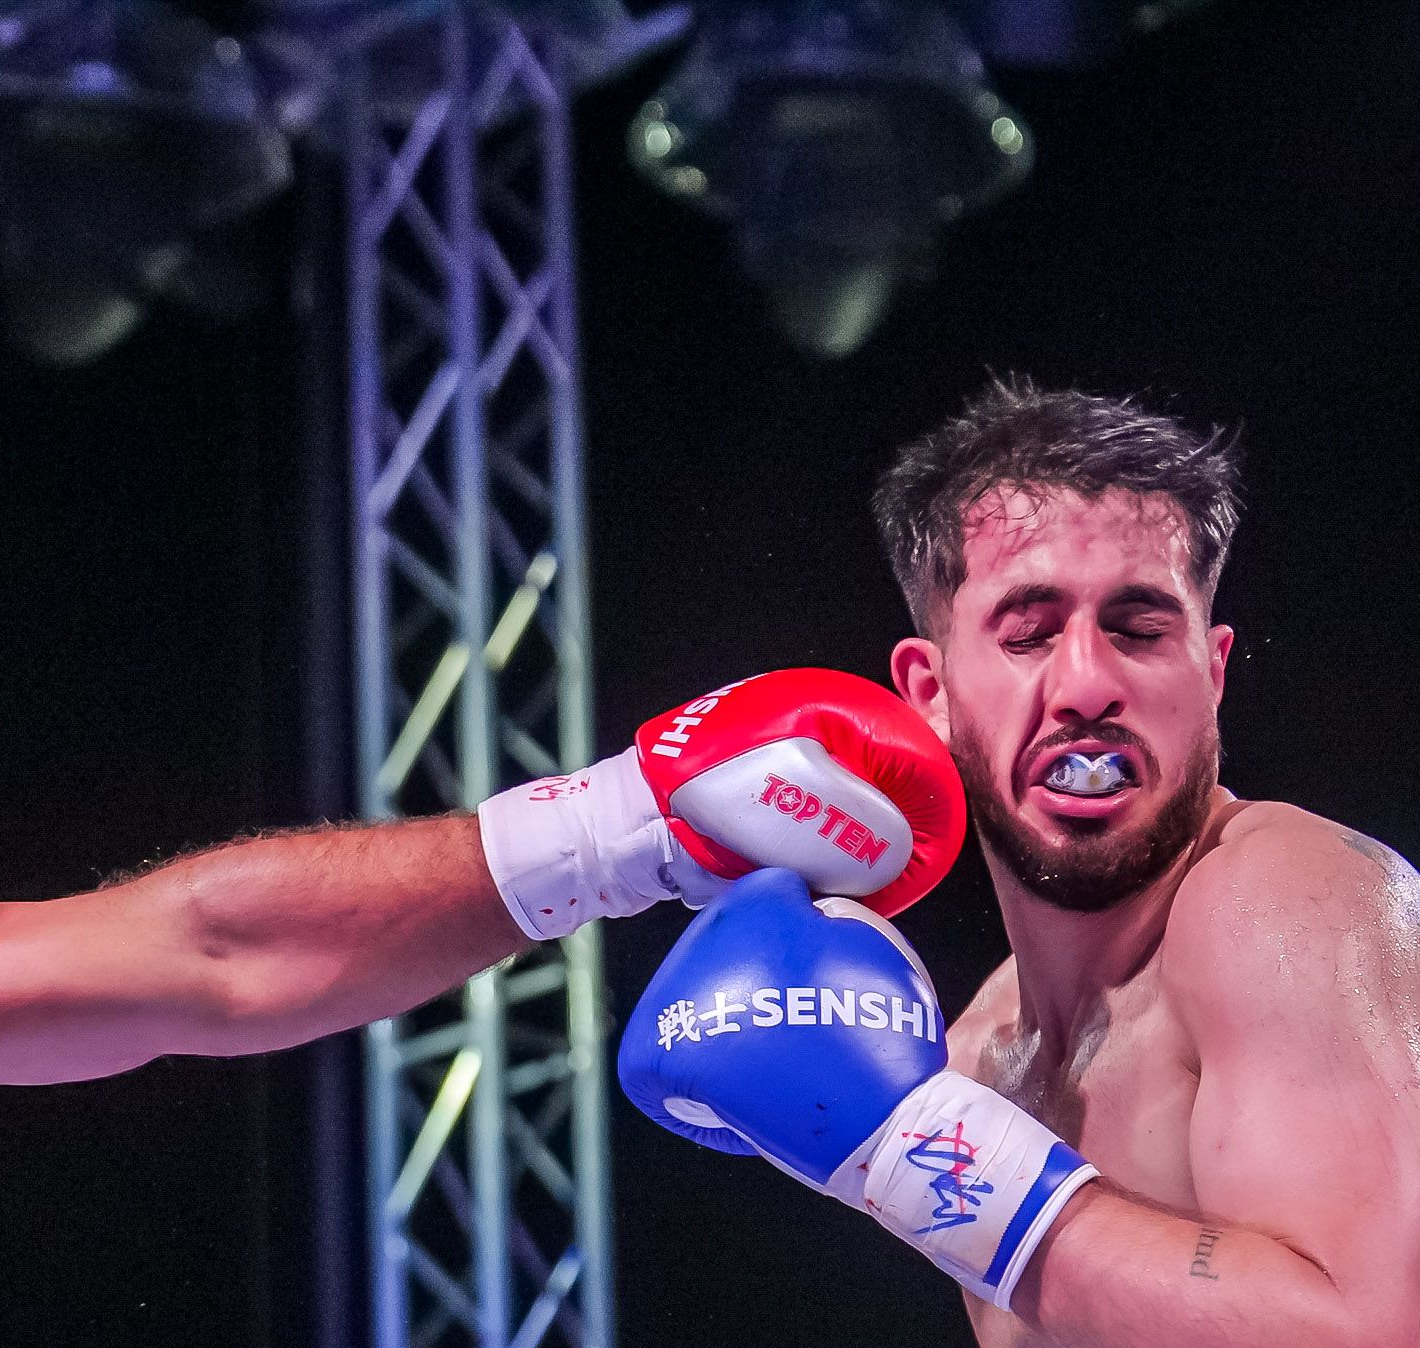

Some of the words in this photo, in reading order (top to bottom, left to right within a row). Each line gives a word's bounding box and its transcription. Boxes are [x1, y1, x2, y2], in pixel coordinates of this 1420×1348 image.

[758, 773, 822, 825] TOP
[817, 804, 891, 869] TEN
[751, 987, 938, 1043] SENSHI
